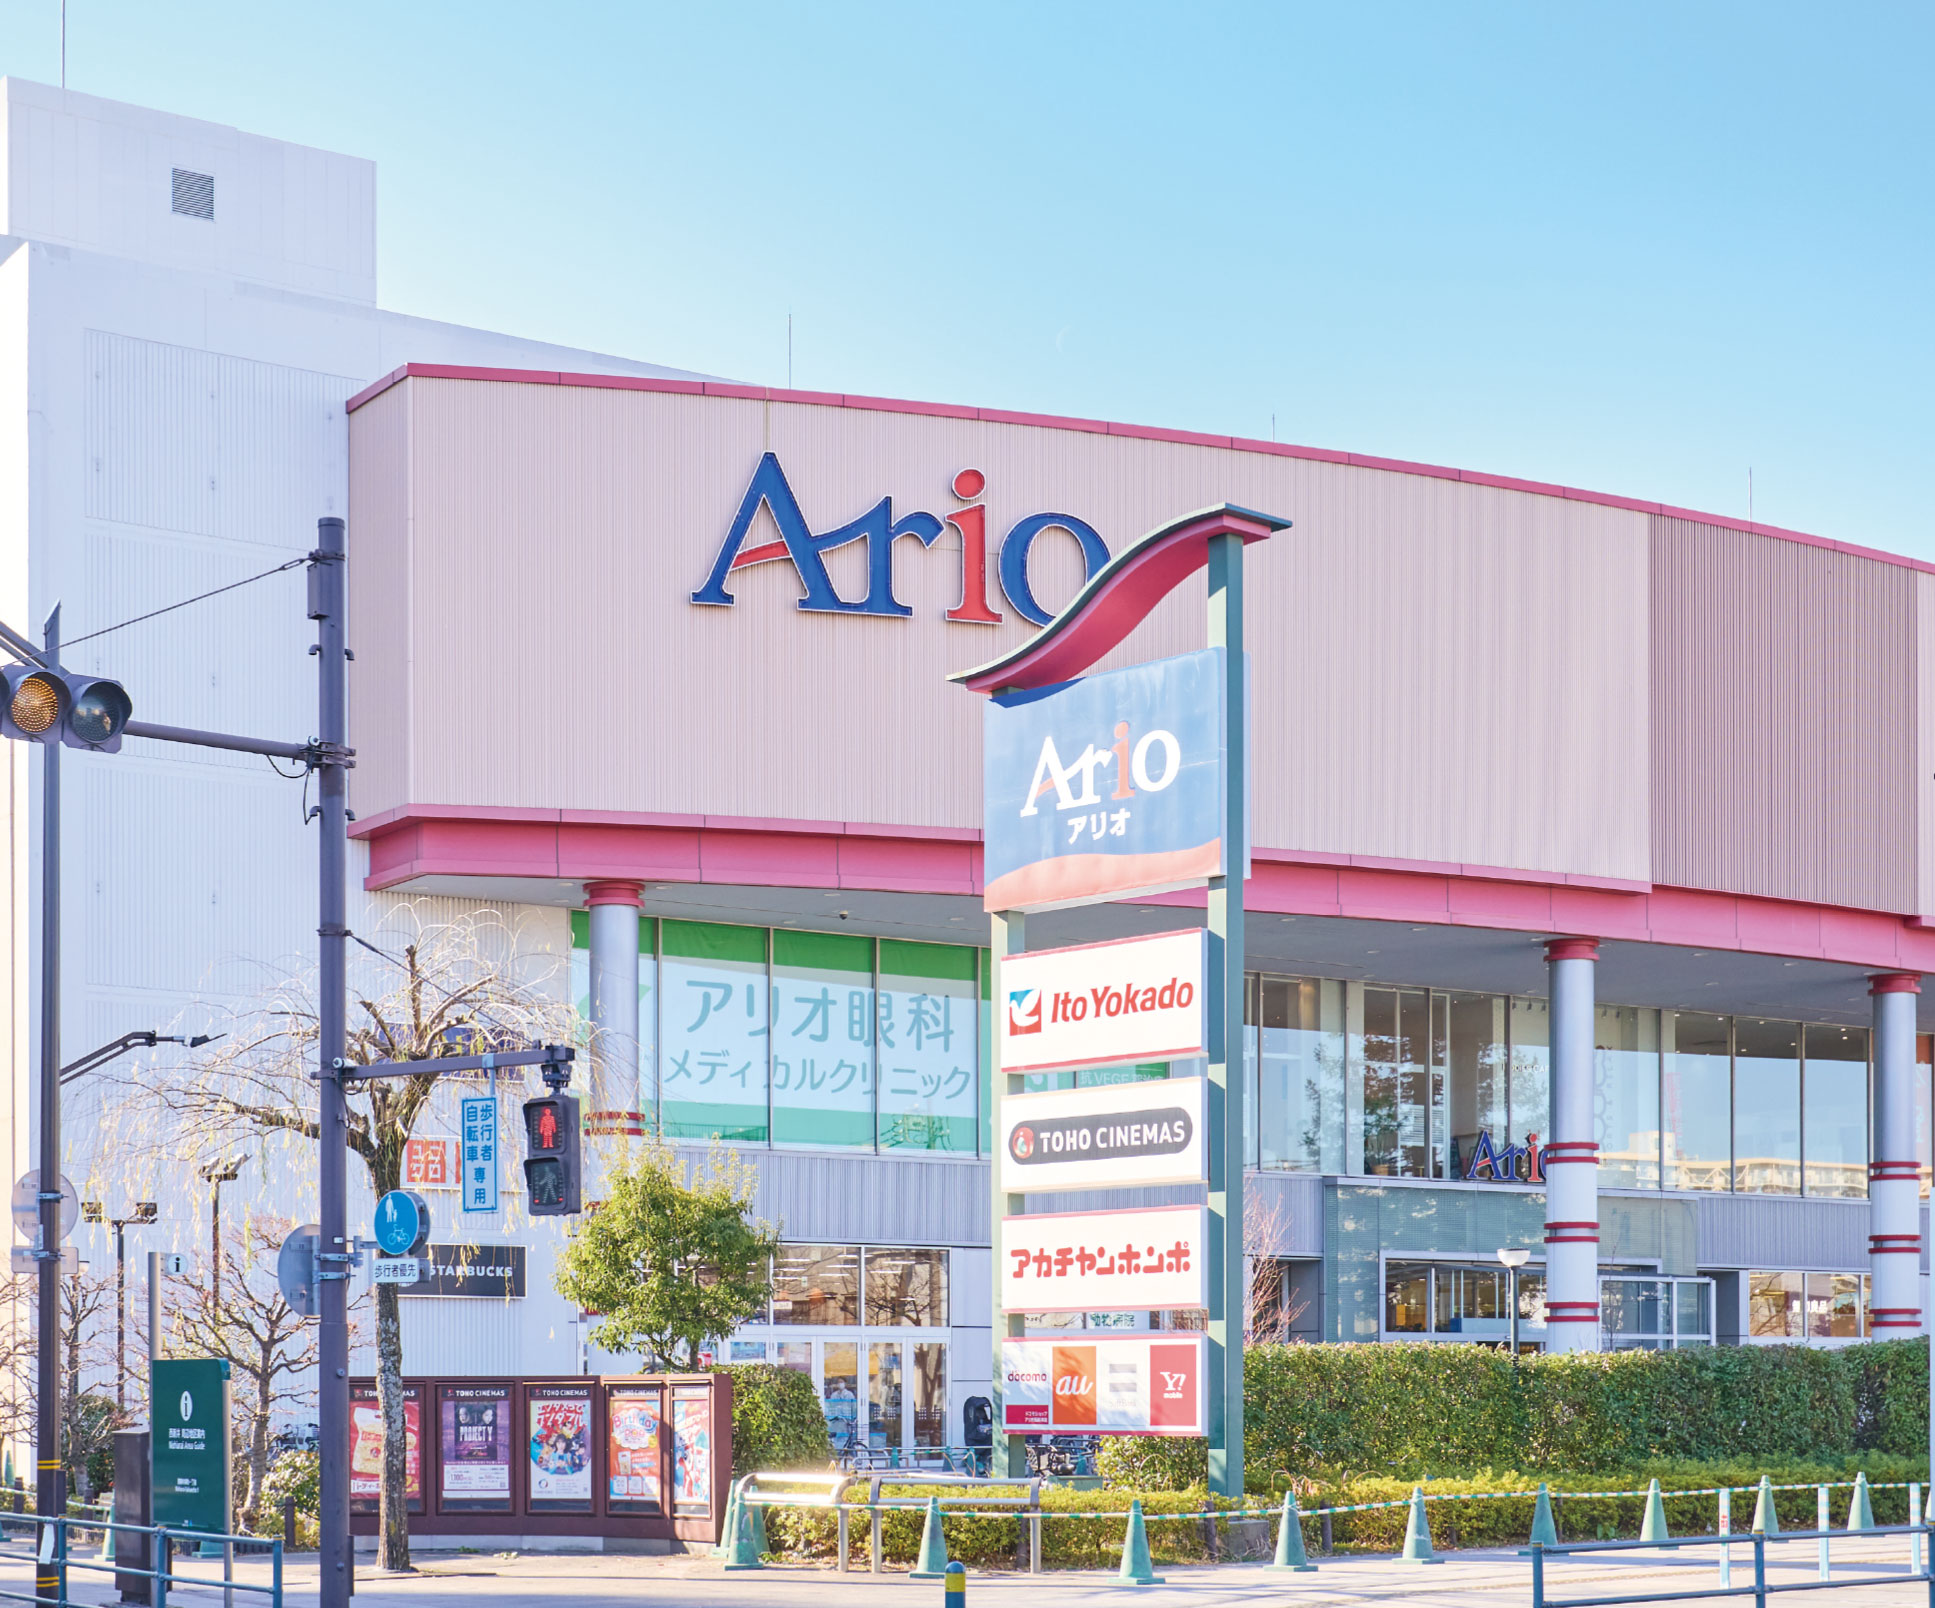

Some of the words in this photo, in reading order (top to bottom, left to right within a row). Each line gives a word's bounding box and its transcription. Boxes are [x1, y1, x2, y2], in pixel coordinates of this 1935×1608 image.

[690, 451, 1111, 629] Ario
[1020, 721, 1181, 818] Ario
[1067, 808, 1131, 844] アリオ
[686, 978, 955, 1053] アリオ眼科
[664, 1048, 971, 1100] メディカルクリニック
[466, 1105, 480, 1162] 自転車
[480, 1105, 493, 1162] 歩行者
[1040, 1129, 1091, 1153] TOHO
[1096, 1121, 1185, 1149] CINEMAS
[1467, 1130, 1547, 1182] Ari
[473, 1166, 486, 1205] 専用
[374, 1263, 418, 1278] 歩行者優先
[430, 1265, 513, 1277] STARBUCKS
[1007, 1370, 1047, 1382] docomo
[1055, 1375, 1093, 1395] au
[460, 1426, 486, 1442] PROJECT
